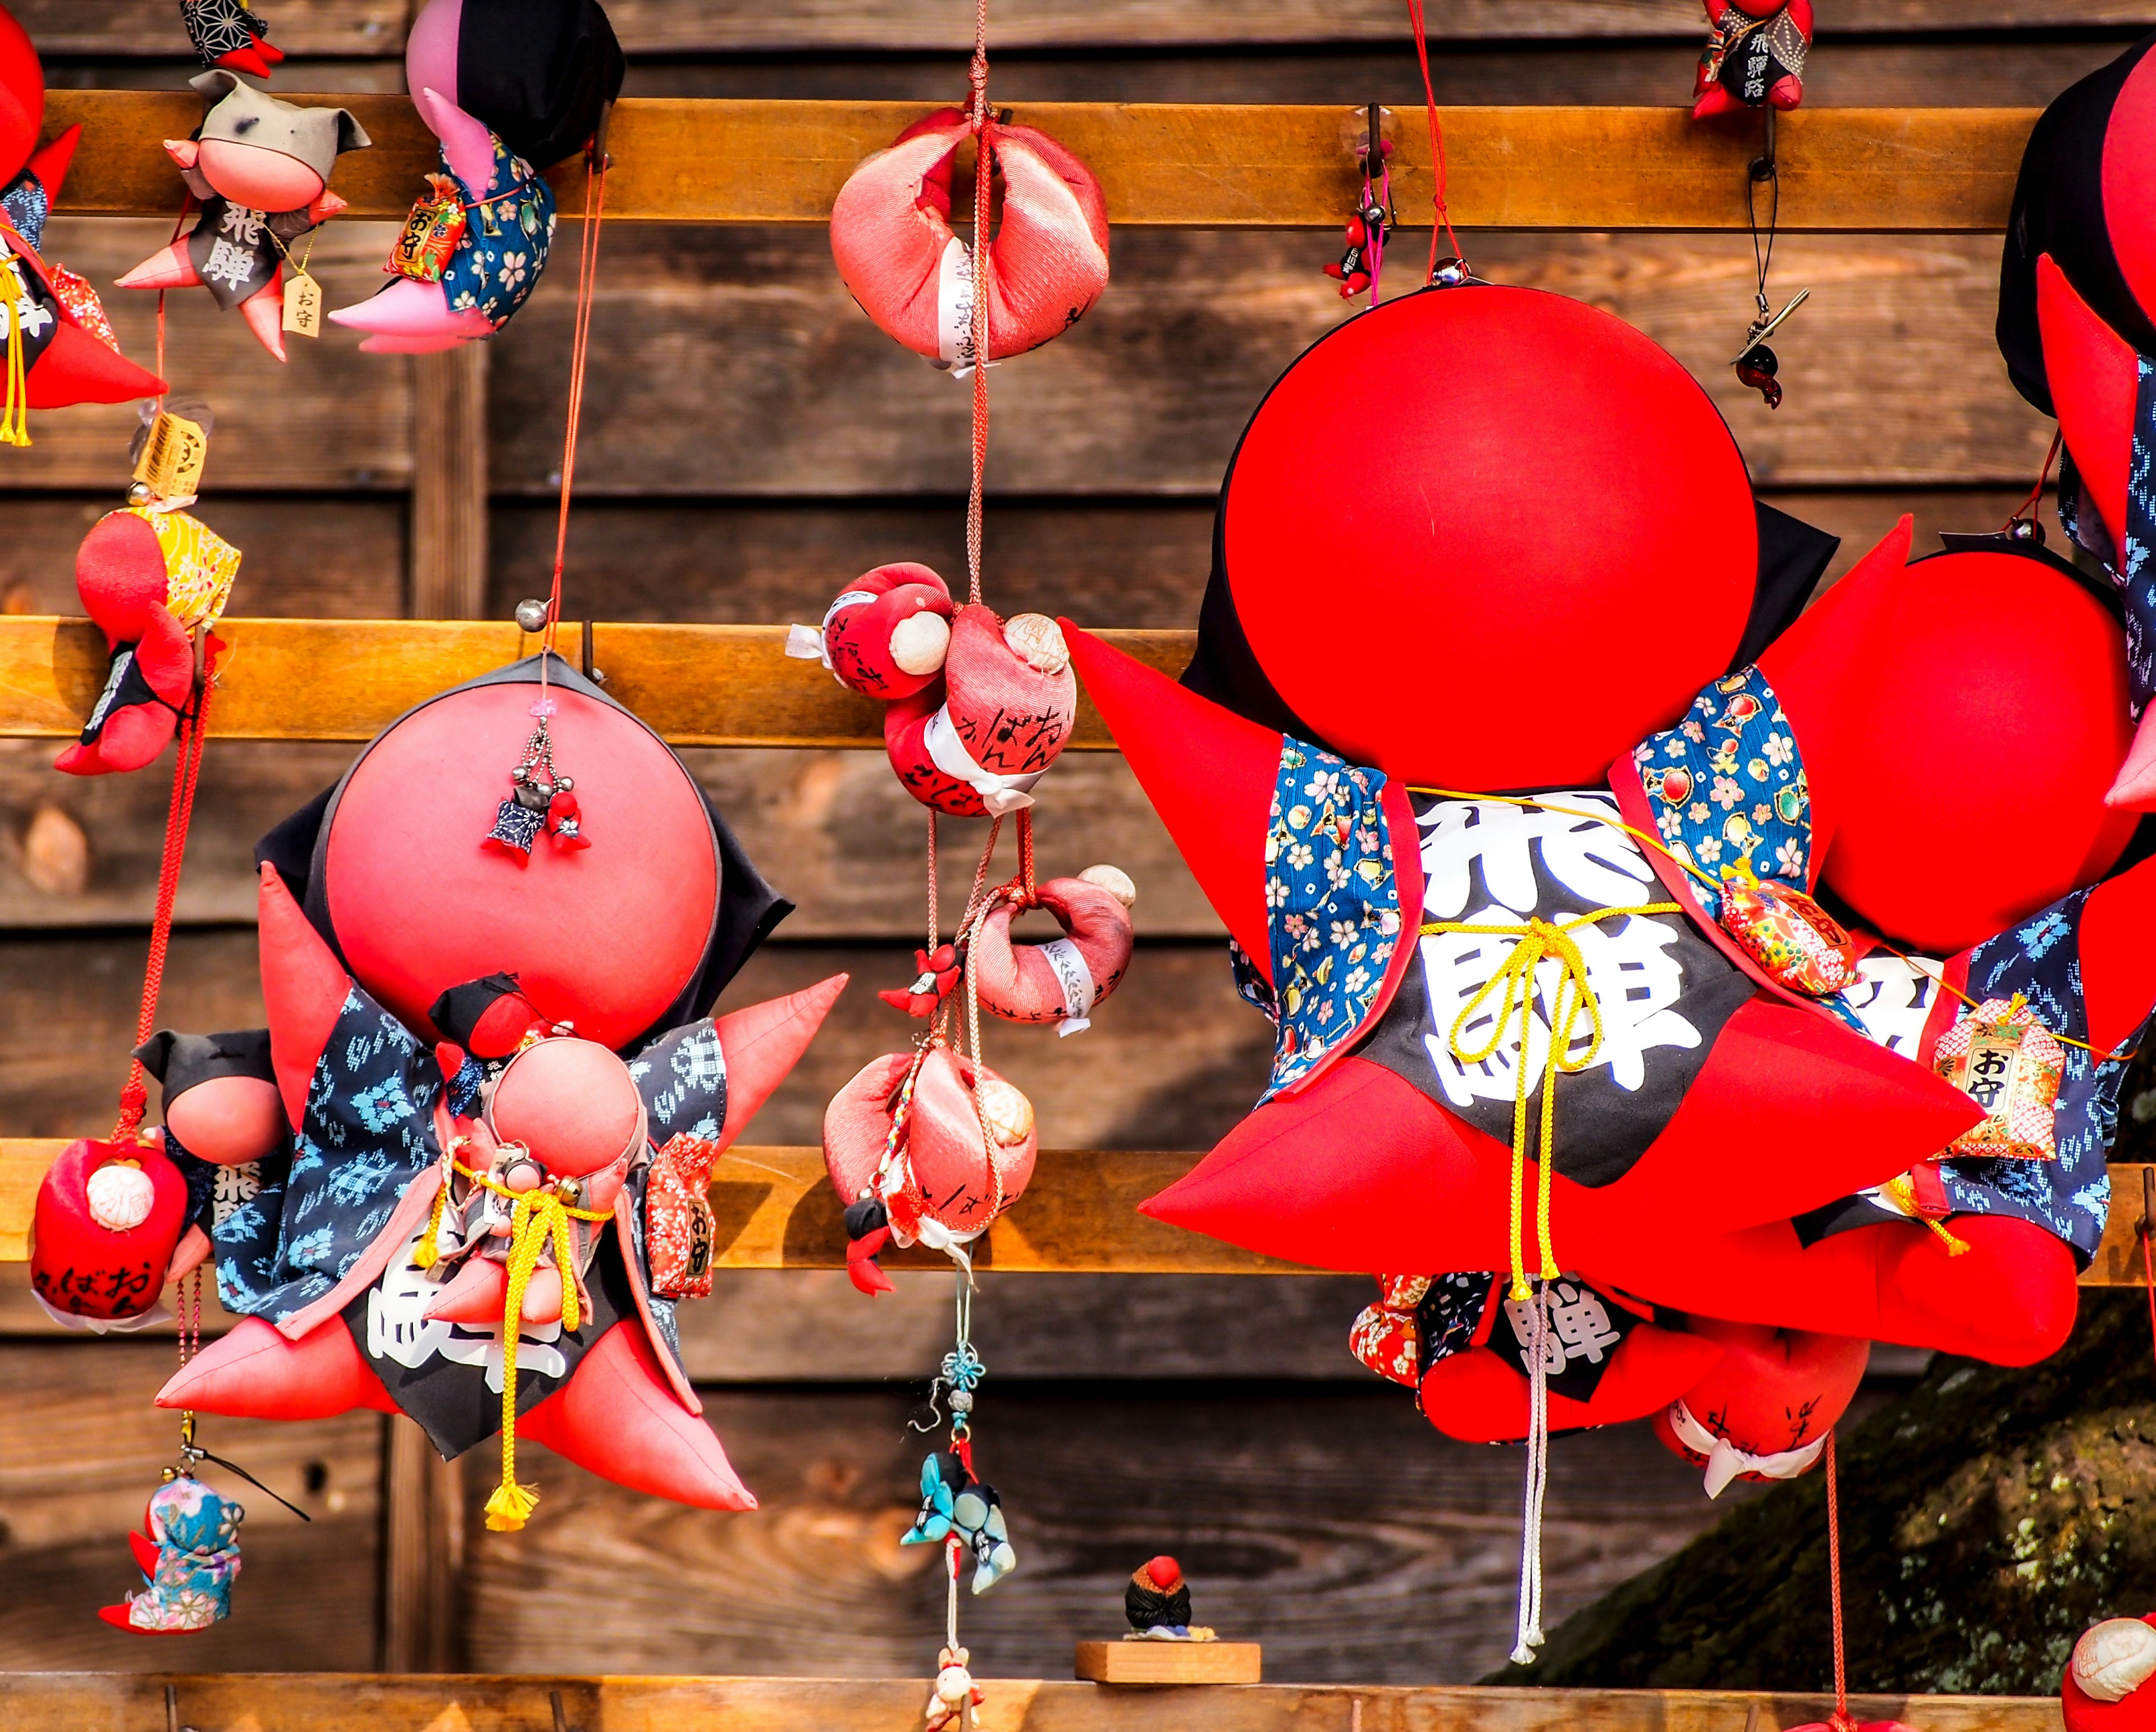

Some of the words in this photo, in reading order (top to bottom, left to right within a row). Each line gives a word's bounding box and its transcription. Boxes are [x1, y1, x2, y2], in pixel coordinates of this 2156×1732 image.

[203, 200, 267, 291] 飛騨
[401, 212, 432, 260] お守
[296, 291, 314, 327] お守
[1417, 790, 1703, 1107] 飛騨
[1968, 1049, 2009, 1108] お守
[691, 1203, 708, 1273] お守
[1502, 1274, 1621, 1375] 騨
